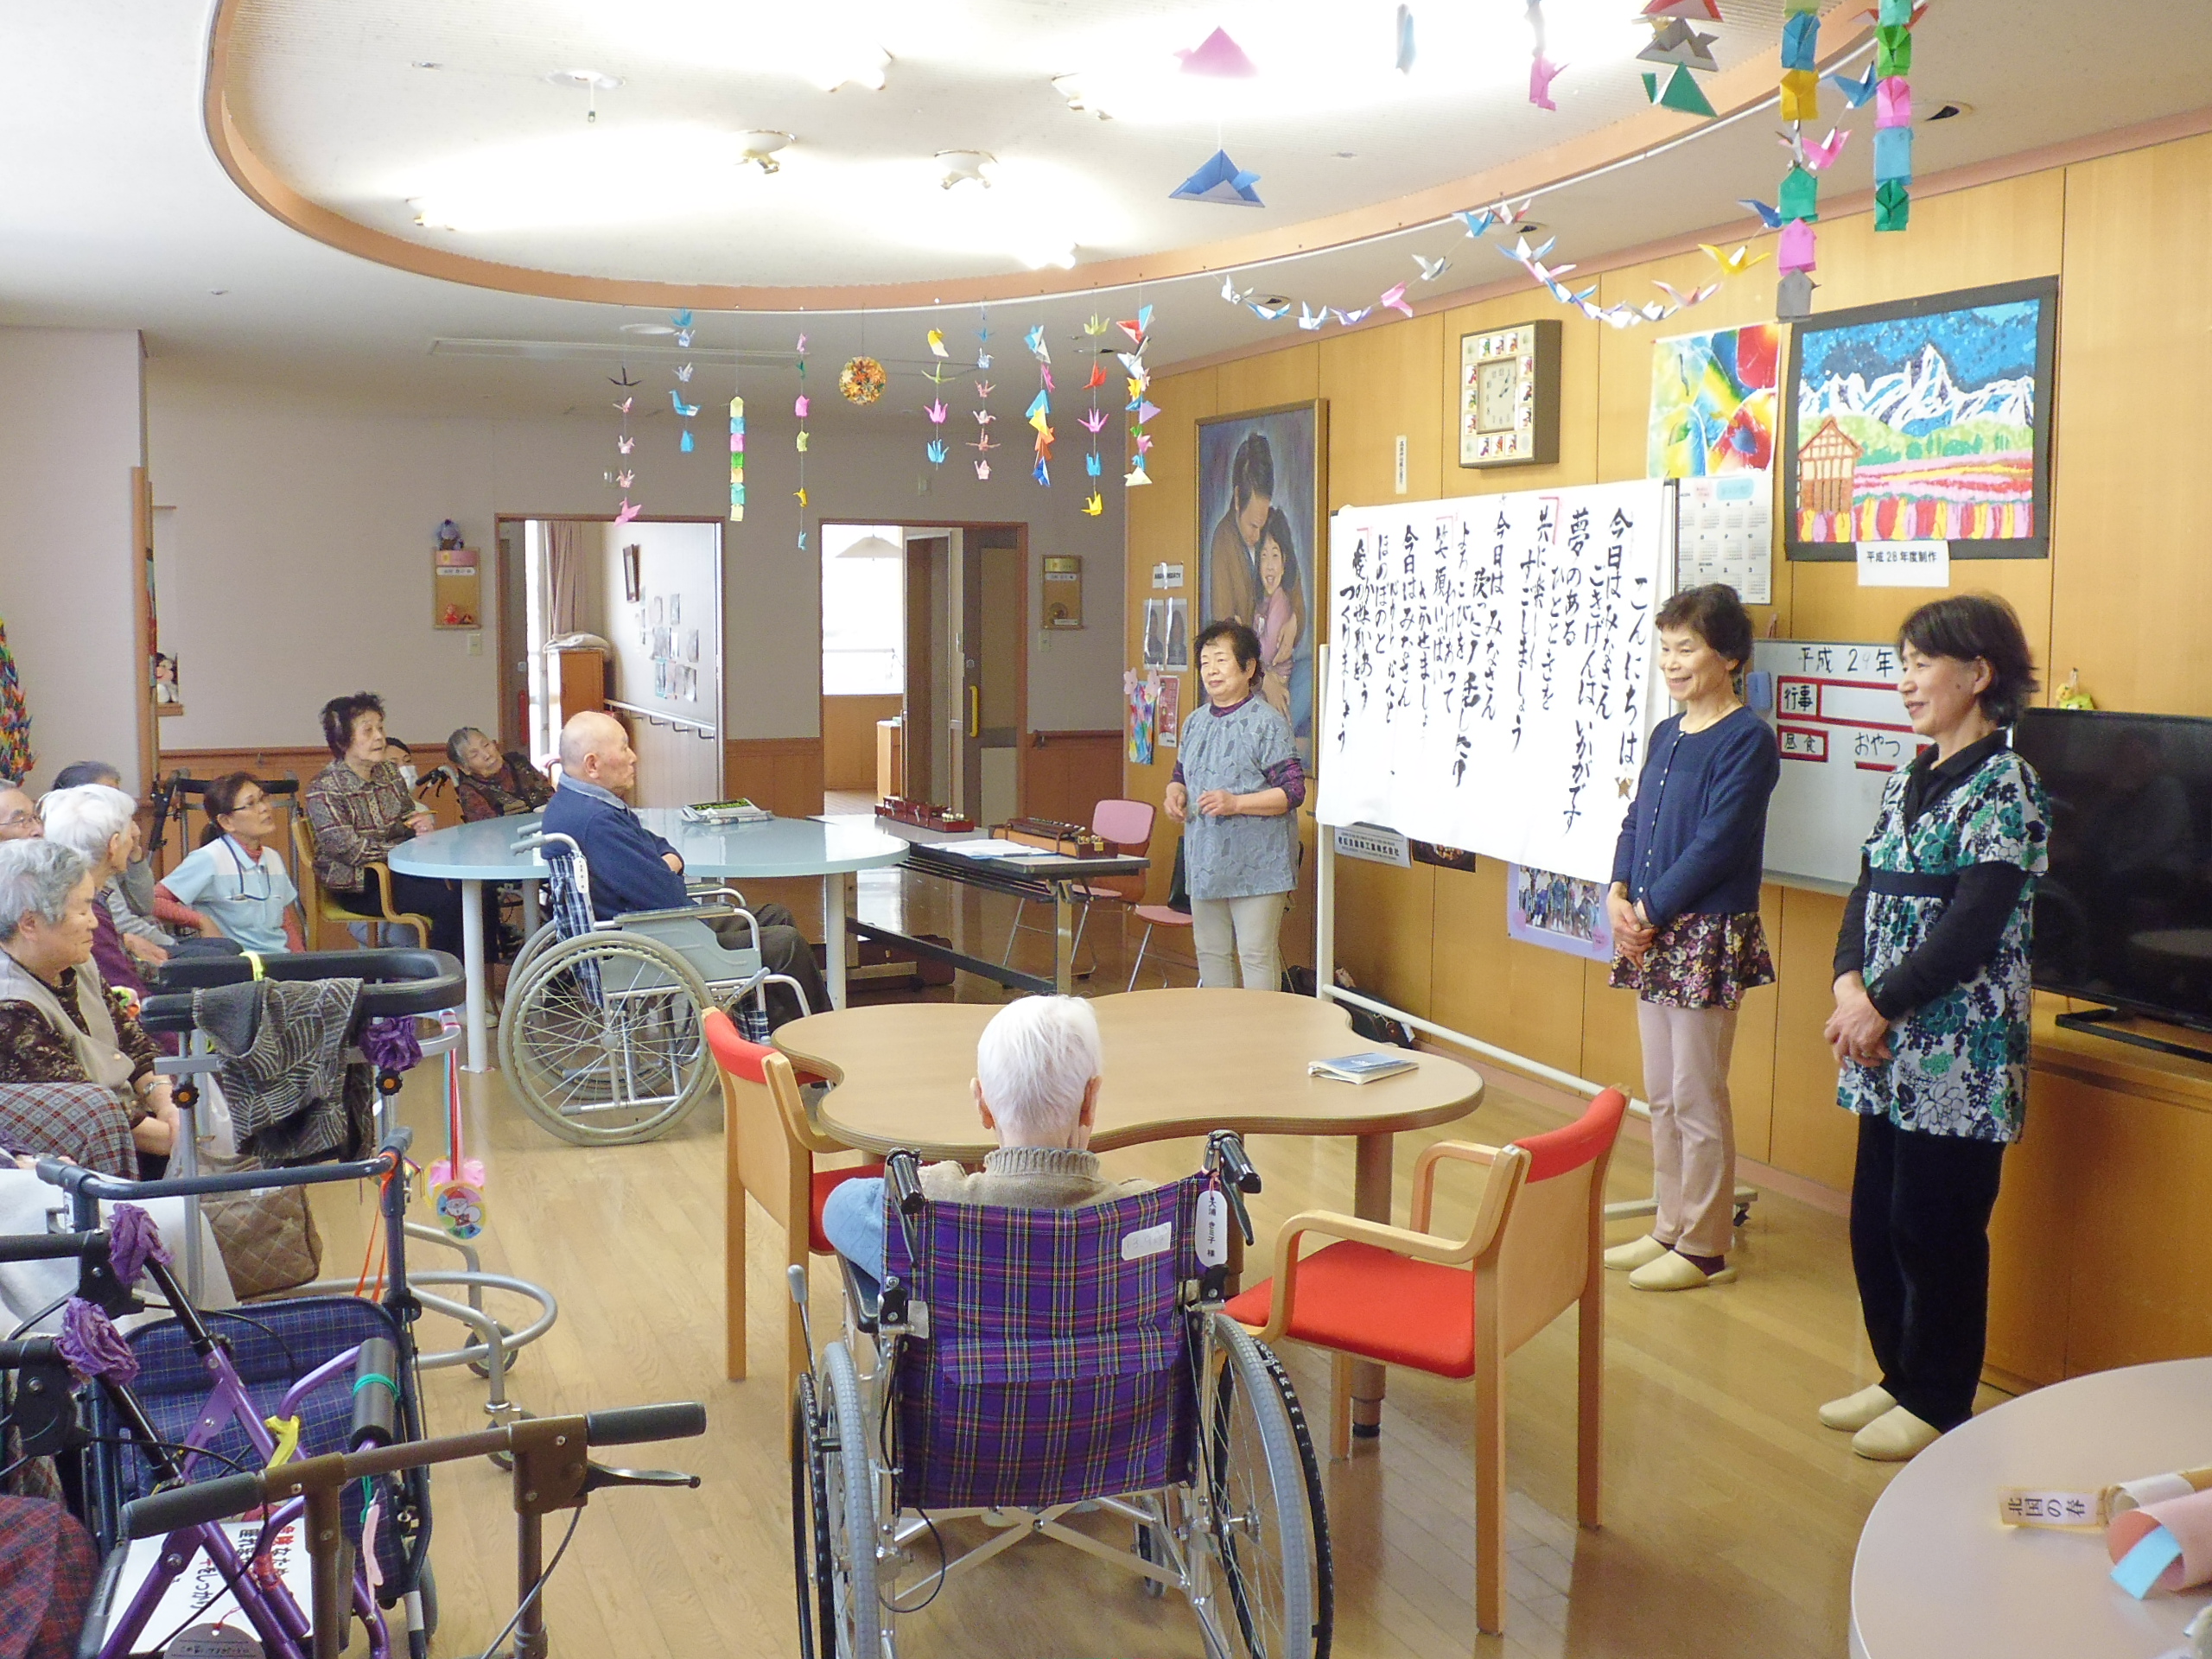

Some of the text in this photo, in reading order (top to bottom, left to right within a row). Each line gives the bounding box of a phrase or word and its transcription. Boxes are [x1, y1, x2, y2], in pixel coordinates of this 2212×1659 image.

[1375, 533, 1389, 654] ほのぼのと
[1455, 520, 1471, 660] よろこびを
[1563, 506, 1591, 646] 夢のある
[1338, 583, 1356, 753] つくりましょう
[1442, 578, 1457, 715] わけあって
[1512, 549, 1536, 753] すごしましょう
[1618, 576, 1649, 766] こんにちは
[1783, 685, 1814, 712] 行事
[1798, 646, 1833, 673] 平成
[1783, 734, 1817, 754] 昼食
[1854, 731, 1901, 759] おやつ
[2007, 1497, 2086, 1518] 北国の春
